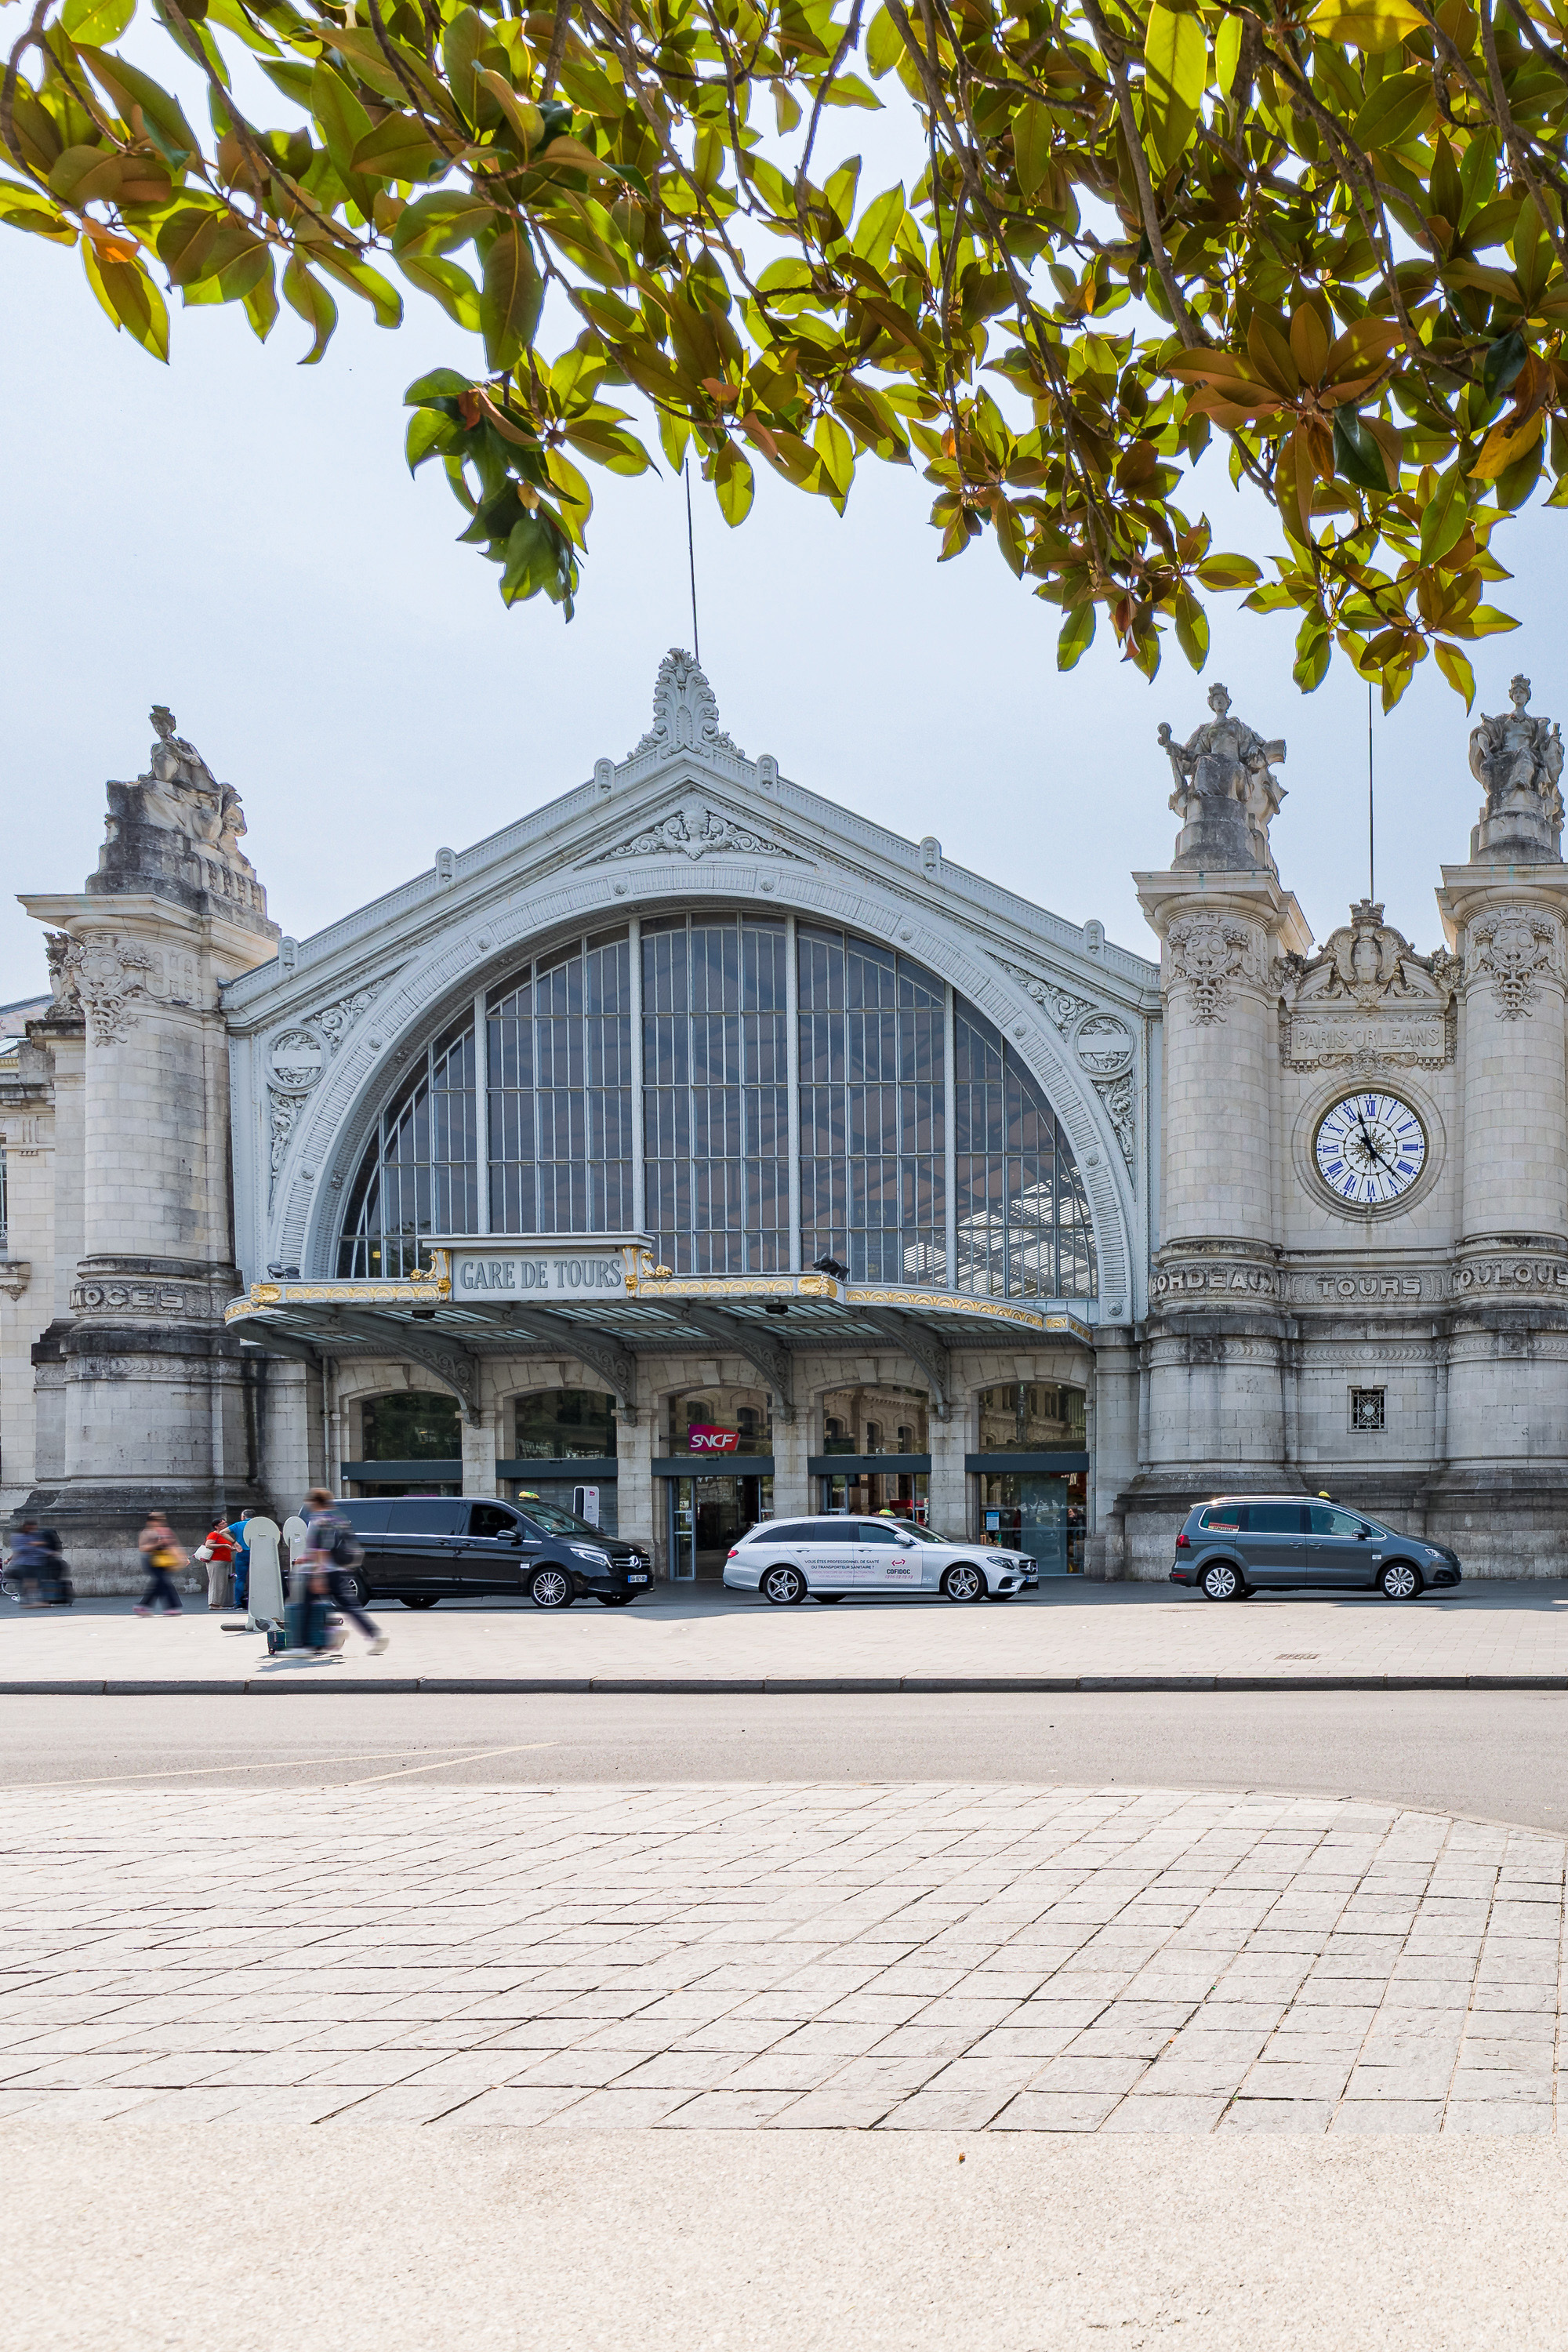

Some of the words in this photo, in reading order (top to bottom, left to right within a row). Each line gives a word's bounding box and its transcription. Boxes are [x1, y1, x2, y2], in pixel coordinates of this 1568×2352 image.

[1342, 1105, 1358, 1123] XI
[1365, 1100, 1376, 1116] XII
[1385, 1105, 1396, 1120] I
[1327, 1123, 1345, 1135] X
[1396, 1121, 1414, 1134] II
[1323, 1145, 1339, 1153] IX
[459, 1261, 515, 1289] GARE
[521, 1261, 548, 1289] DE
[554, 1259, 622, 1288] TOURS
[1317, 1277, 1421, 1296] TOURS
[690, 1434, 736, 1448] SNCF
